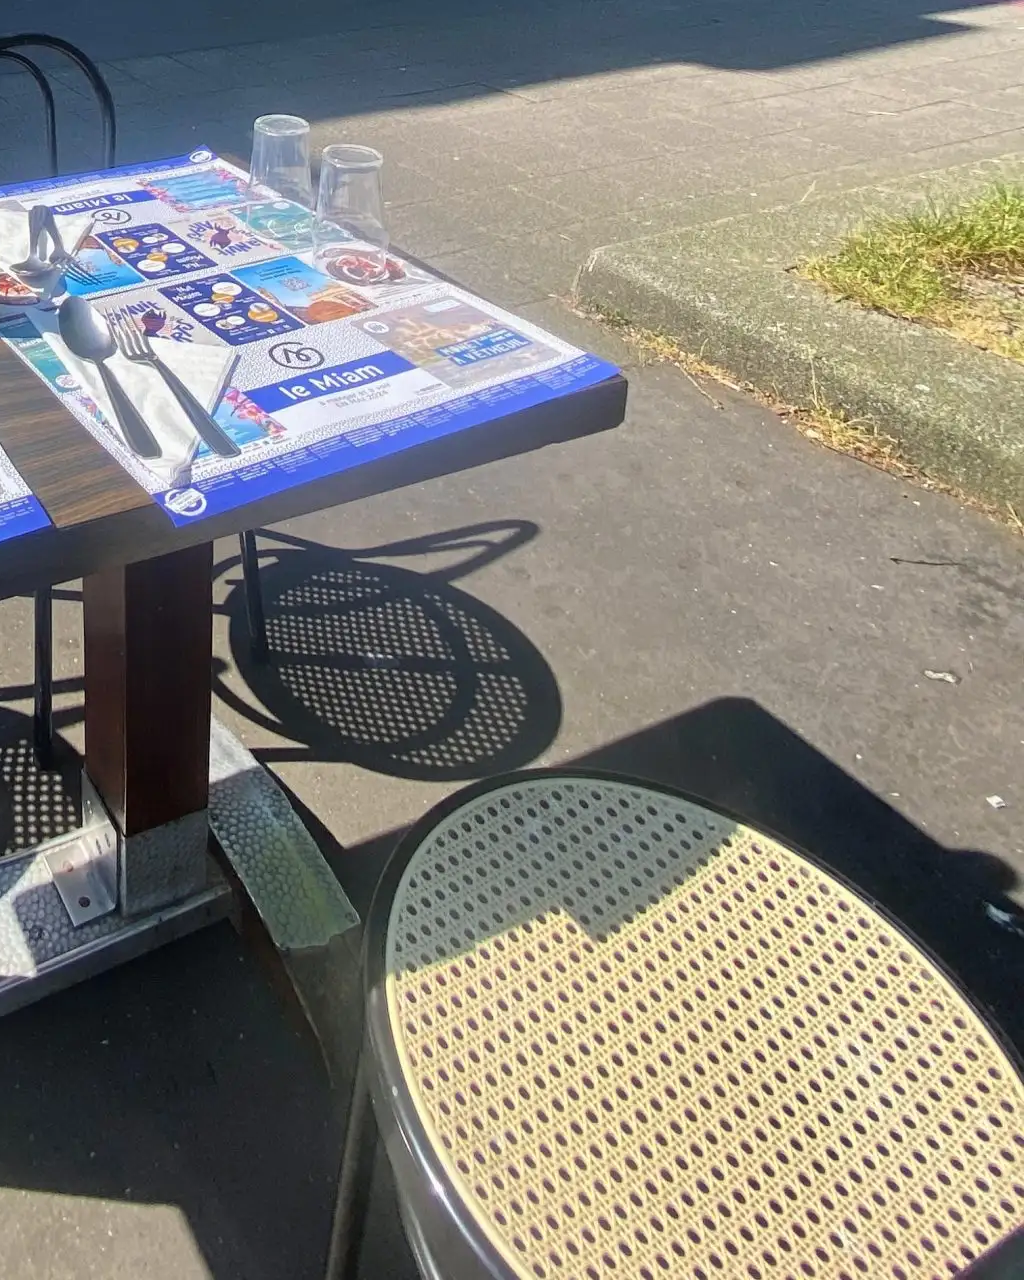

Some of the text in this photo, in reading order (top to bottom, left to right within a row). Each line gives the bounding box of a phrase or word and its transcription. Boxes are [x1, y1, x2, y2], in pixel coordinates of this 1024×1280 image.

[54, 196, 110, 212] Miam
[278, 365, 384, 400] le Miam
